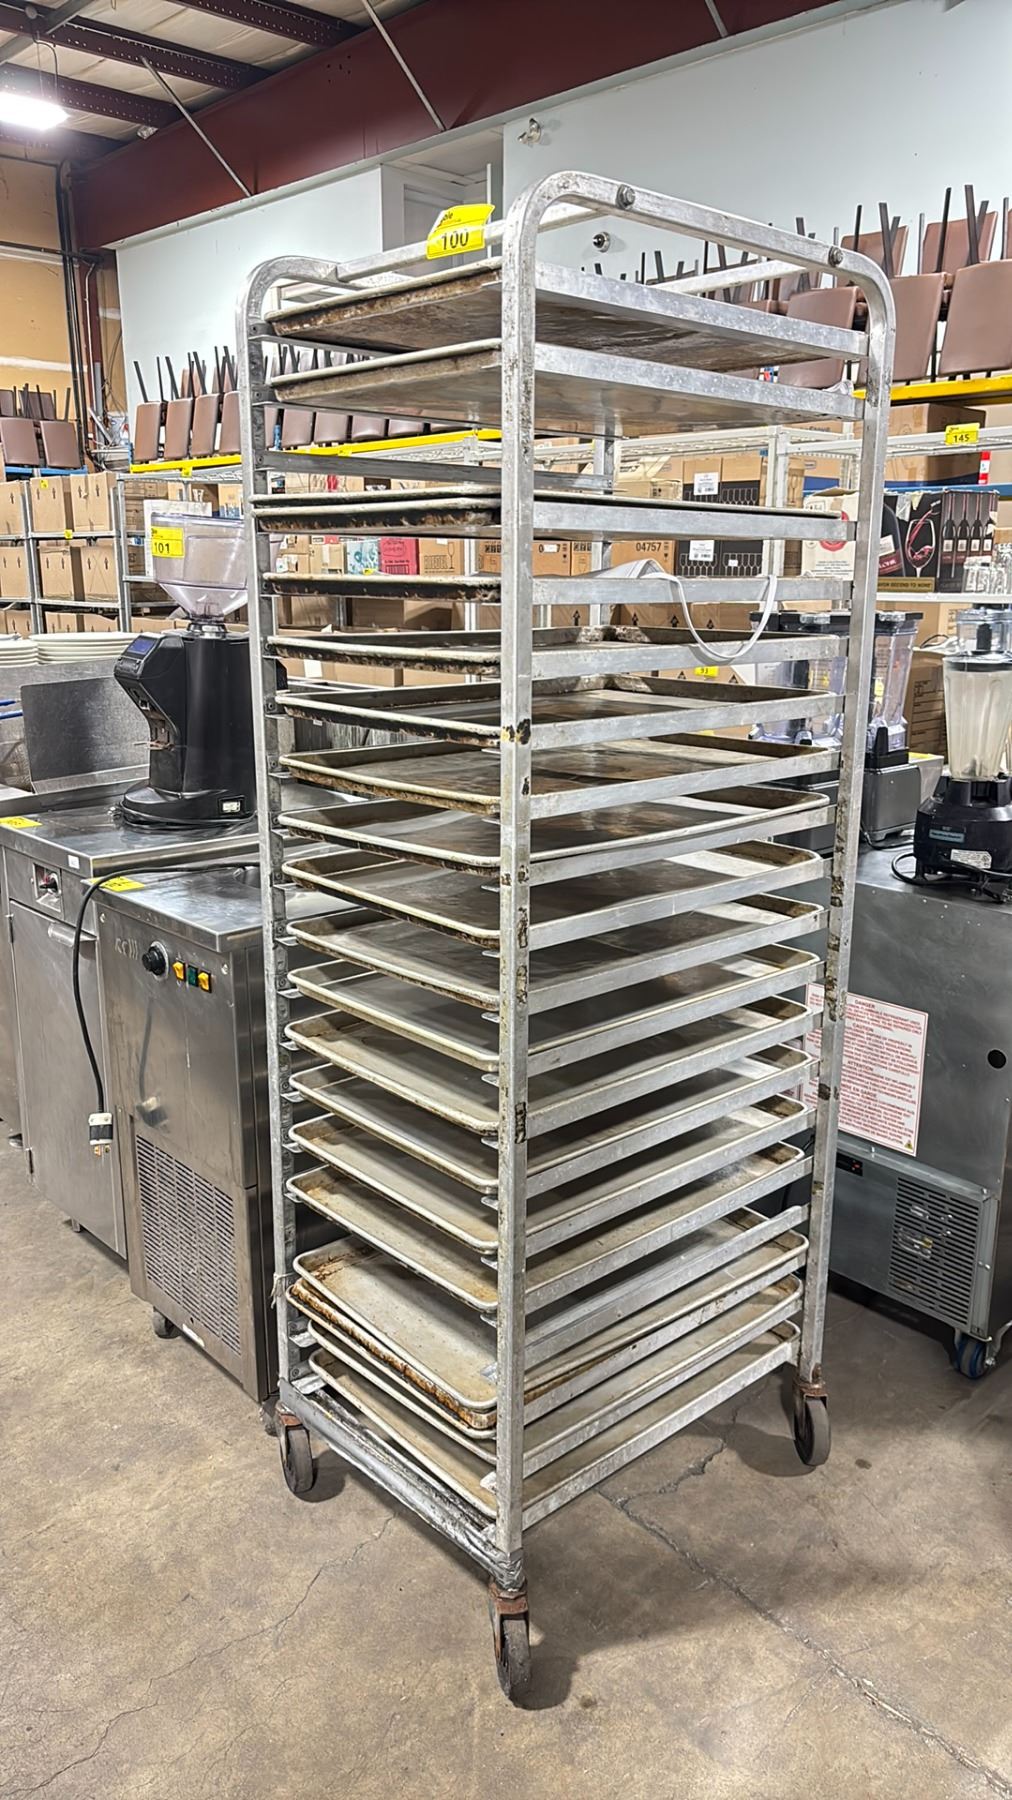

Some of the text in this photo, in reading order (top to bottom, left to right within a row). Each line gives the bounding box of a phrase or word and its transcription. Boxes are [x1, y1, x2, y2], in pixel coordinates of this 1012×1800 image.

[441, 229, 469, 250] 100
[954, 433, 970, 443] 145
[154, 542, 170, 554] 101
[635, 541, 662, 552] 04757
[855, 999, 875, 1009] DANGER
[852, 1022, 874, 1033] CAUTION
[847, 1060, 874, 1072] ATTENTION
